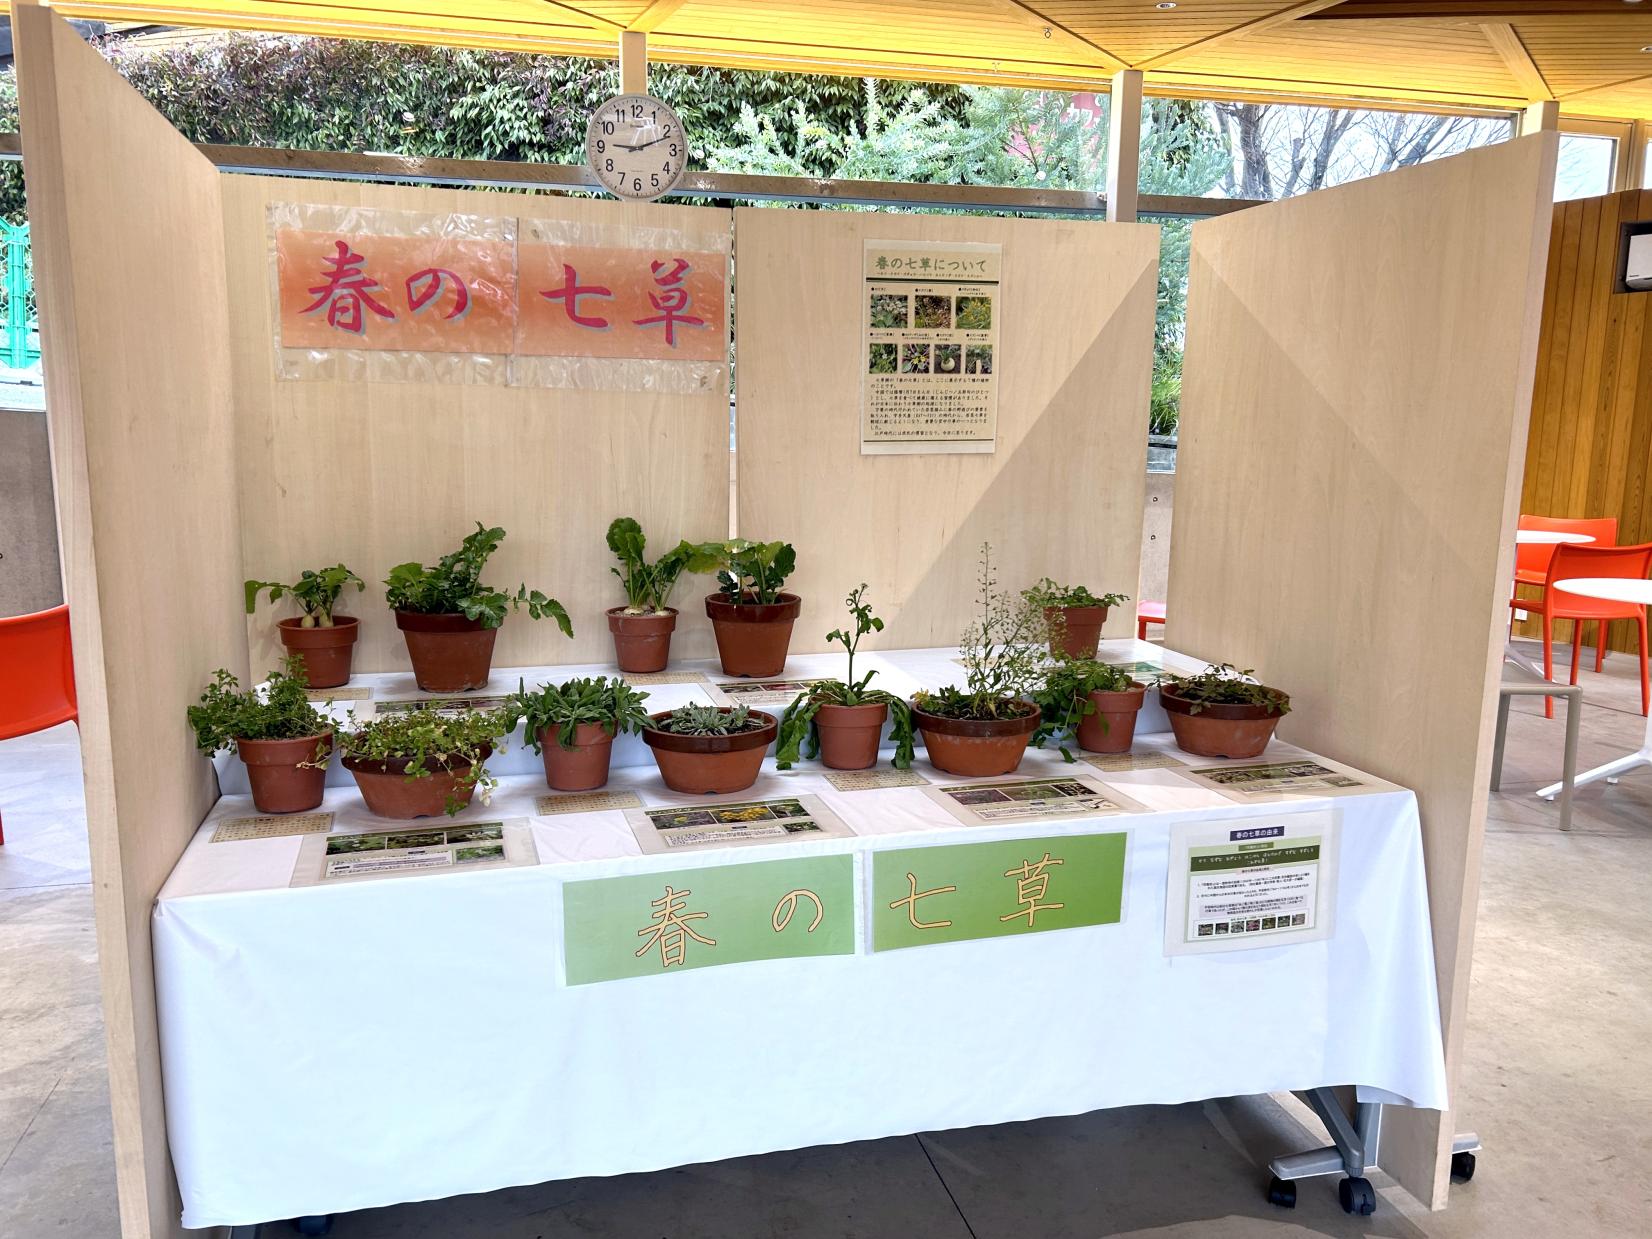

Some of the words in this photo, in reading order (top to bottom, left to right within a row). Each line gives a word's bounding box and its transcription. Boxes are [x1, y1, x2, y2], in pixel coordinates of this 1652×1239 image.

[615, 109, 625, 123] 11
[631, 105, 643, 118] 12
[651, 111, 656, 124] 1
[601, 121, 614, 135] 10
[663, 125, 671, 138] 2
[597, 140, 605, 153] 9
[669, 143, 677, 157] 3
[606, 158, 614, 172] 8
[663, 161, 671, 174] 4
[617, 172, 626, 185] 7
[633, 178, 642, 191] 6
[651, 174, 659, 187] 5
[875, 256, 987, 272] 春の七草について
[1236, 828, 1279, 839] 春の七草の由来
